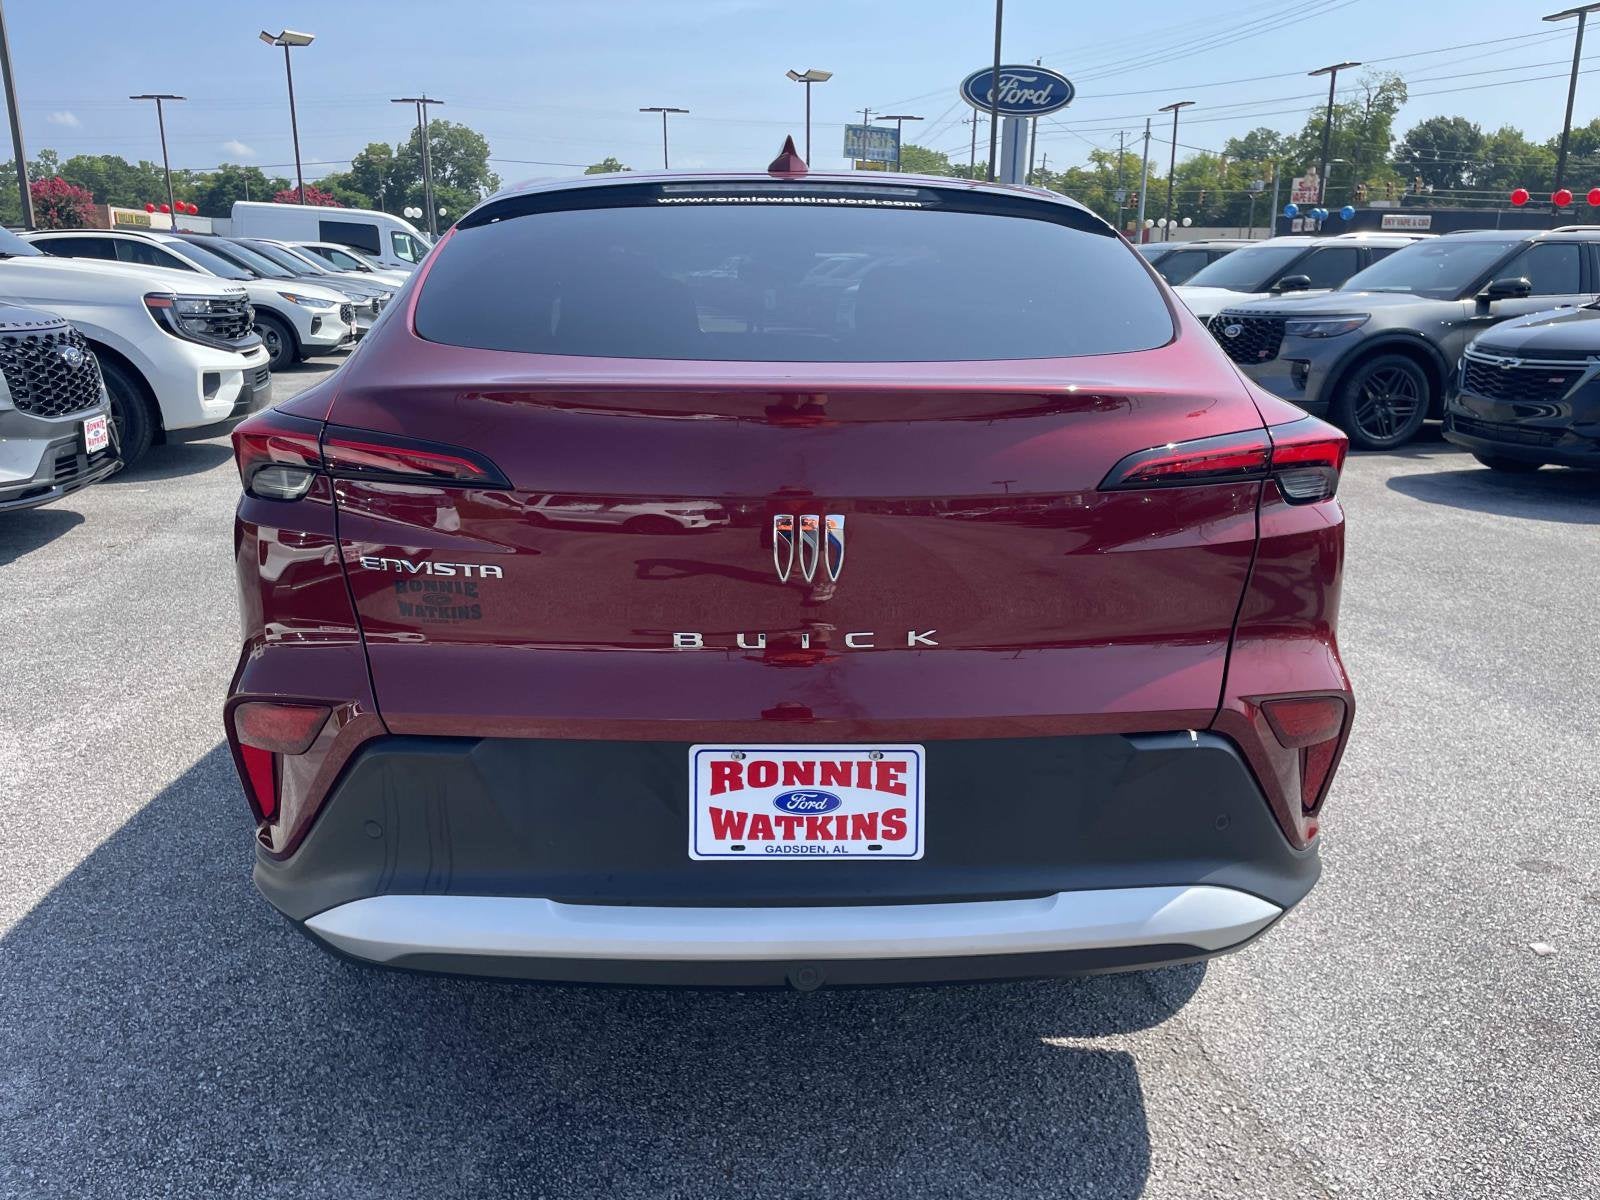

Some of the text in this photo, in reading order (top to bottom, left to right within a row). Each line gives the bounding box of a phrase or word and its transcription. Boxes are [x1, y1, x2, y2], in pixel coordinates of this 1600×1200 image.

[987, 73, 1051, 105] Ford
[657, 195, 922, 207] www.ronniewatkinsford.com
[360, 556, 503, 579] ENVISTA
[395, 580, 479, 598] RONNIE
[398, 604, 482, 619] WATKINS
[673, 629, 939, 649] BUICK
[710, 760, 907, 796] RONNIE
[786, 794, 828, 810] Ford
[709, 806, 908, 841] WATKINS
[765, 845, 849, 854] GADSDEN, AL
